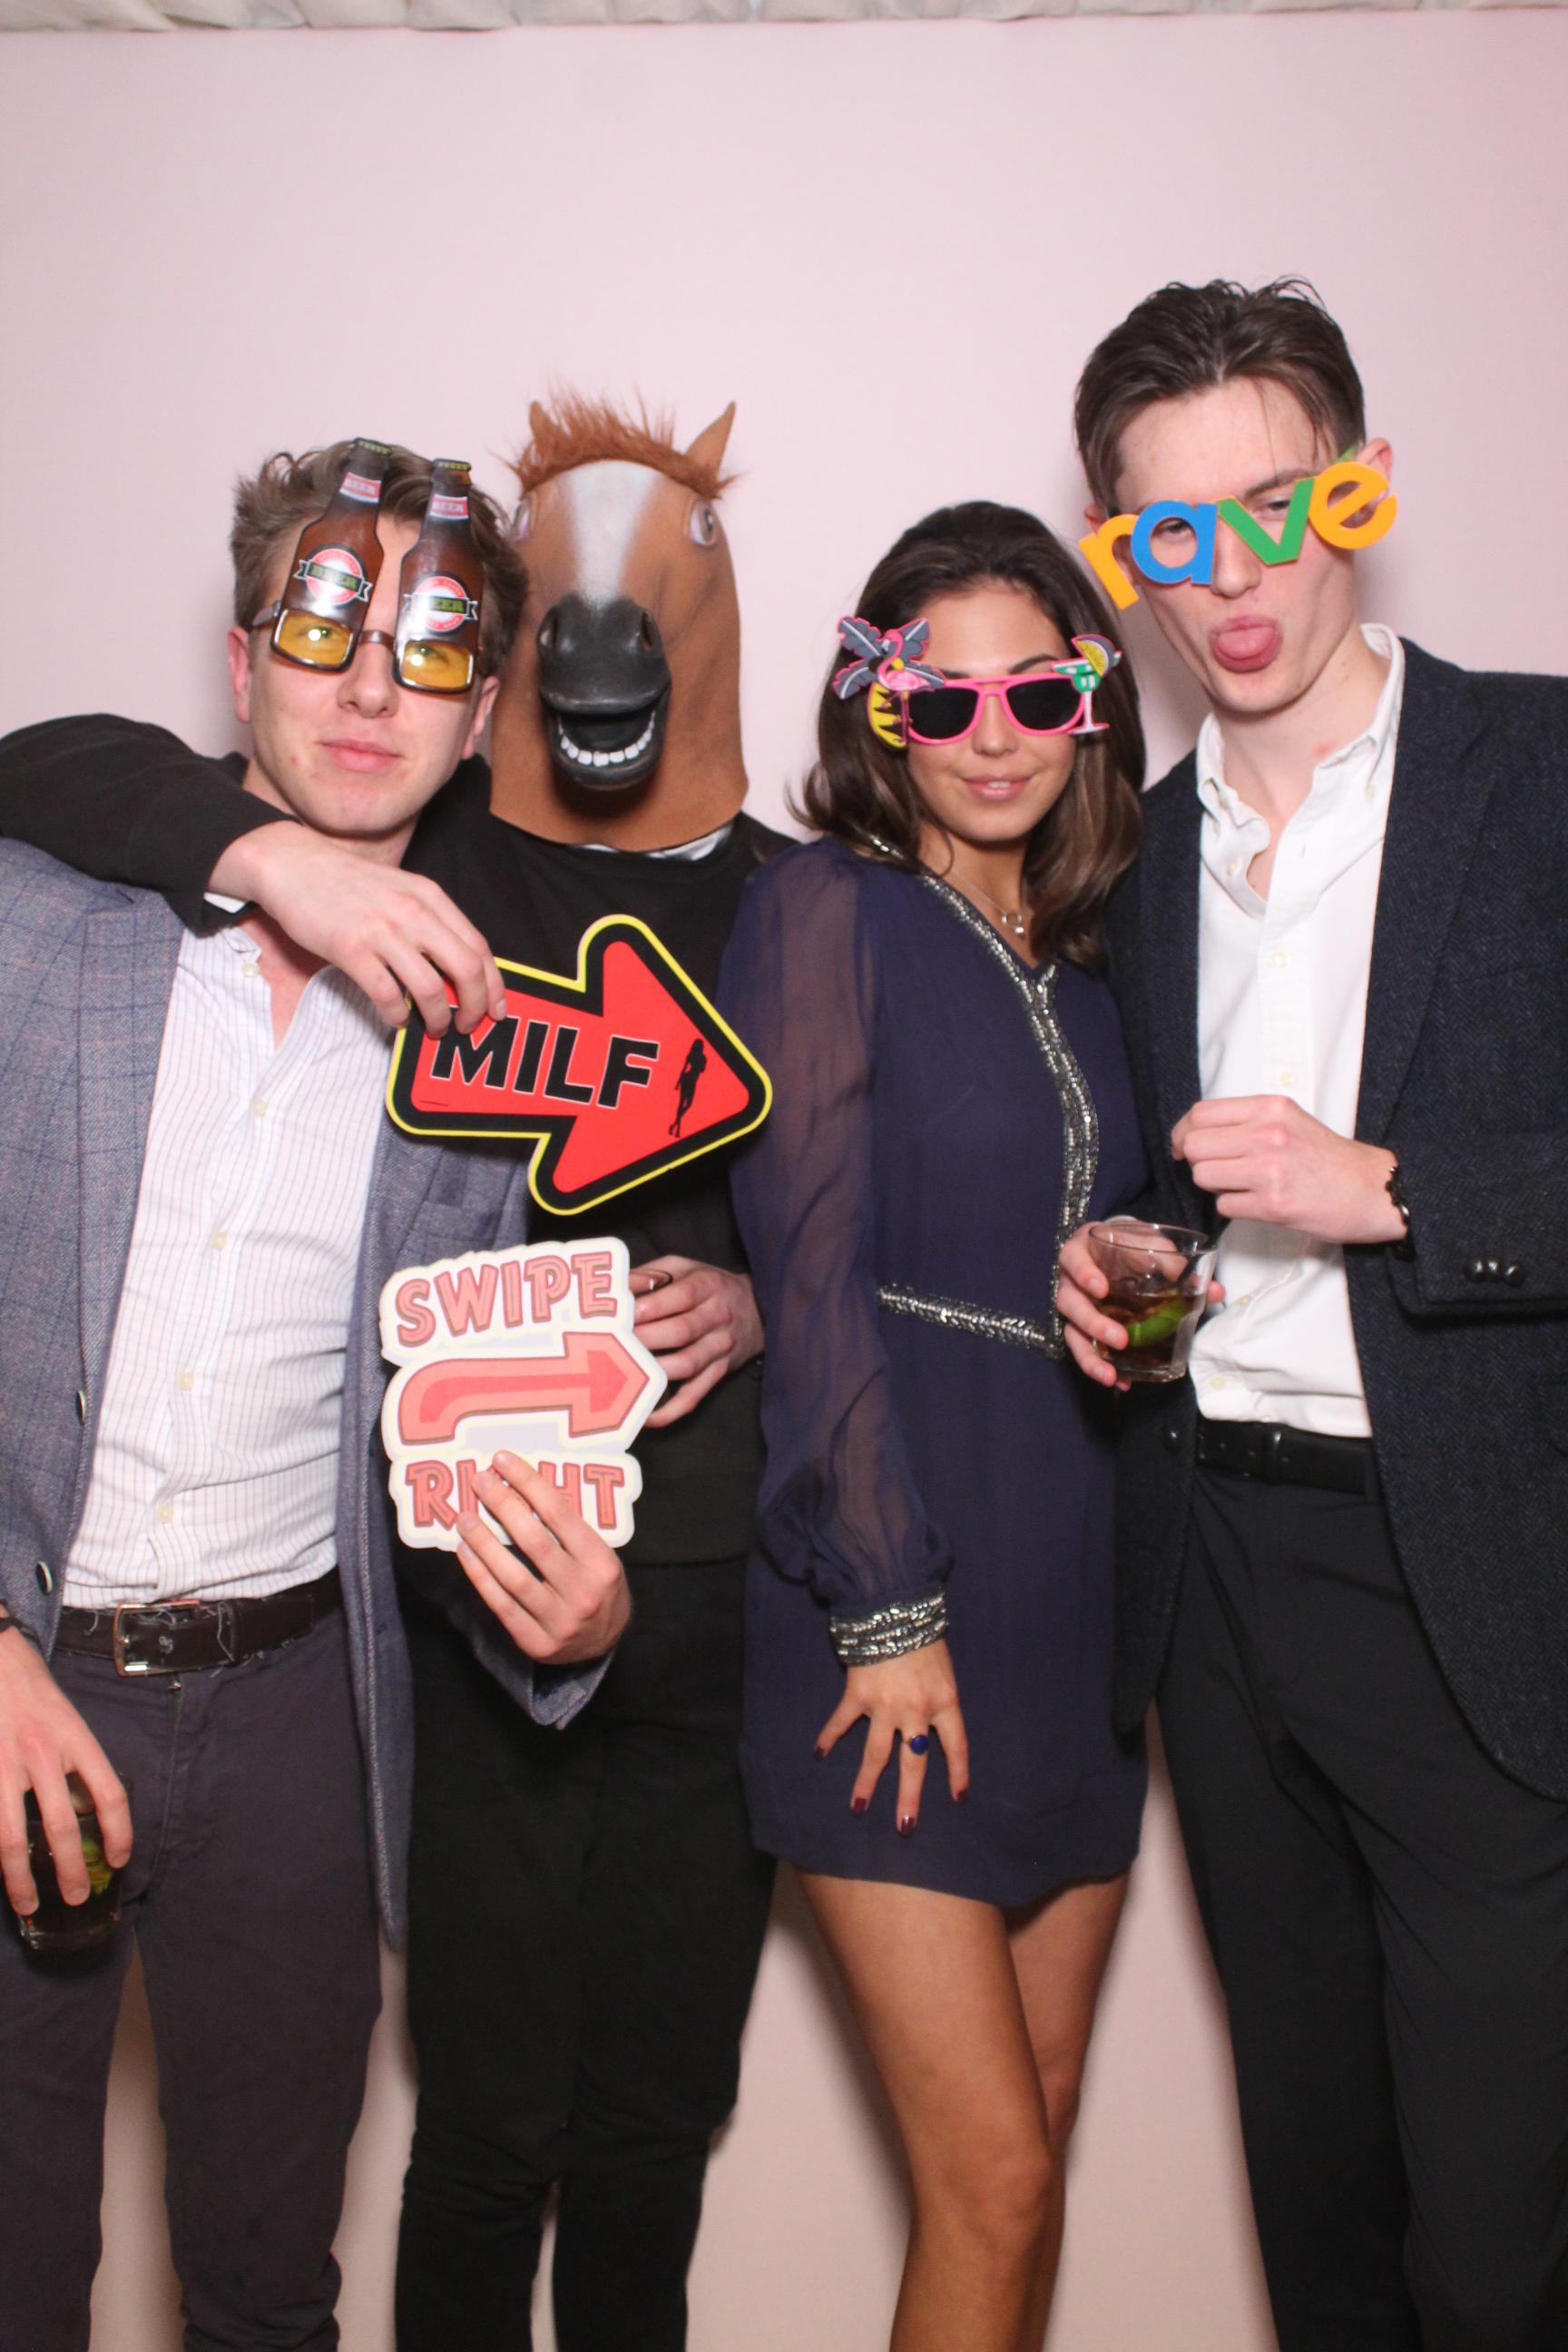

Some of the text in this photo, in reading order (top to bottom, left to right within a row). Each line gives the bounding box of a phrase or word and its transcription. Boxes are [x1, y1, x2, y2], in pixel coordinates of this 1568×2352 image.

[1078, 461, 1397, 610] rave
[430, 1004, 660, 1109] MILF
[396, 1251, 617, 1348] SWIPE
[406, 1459, 625, 1531] RIHT
